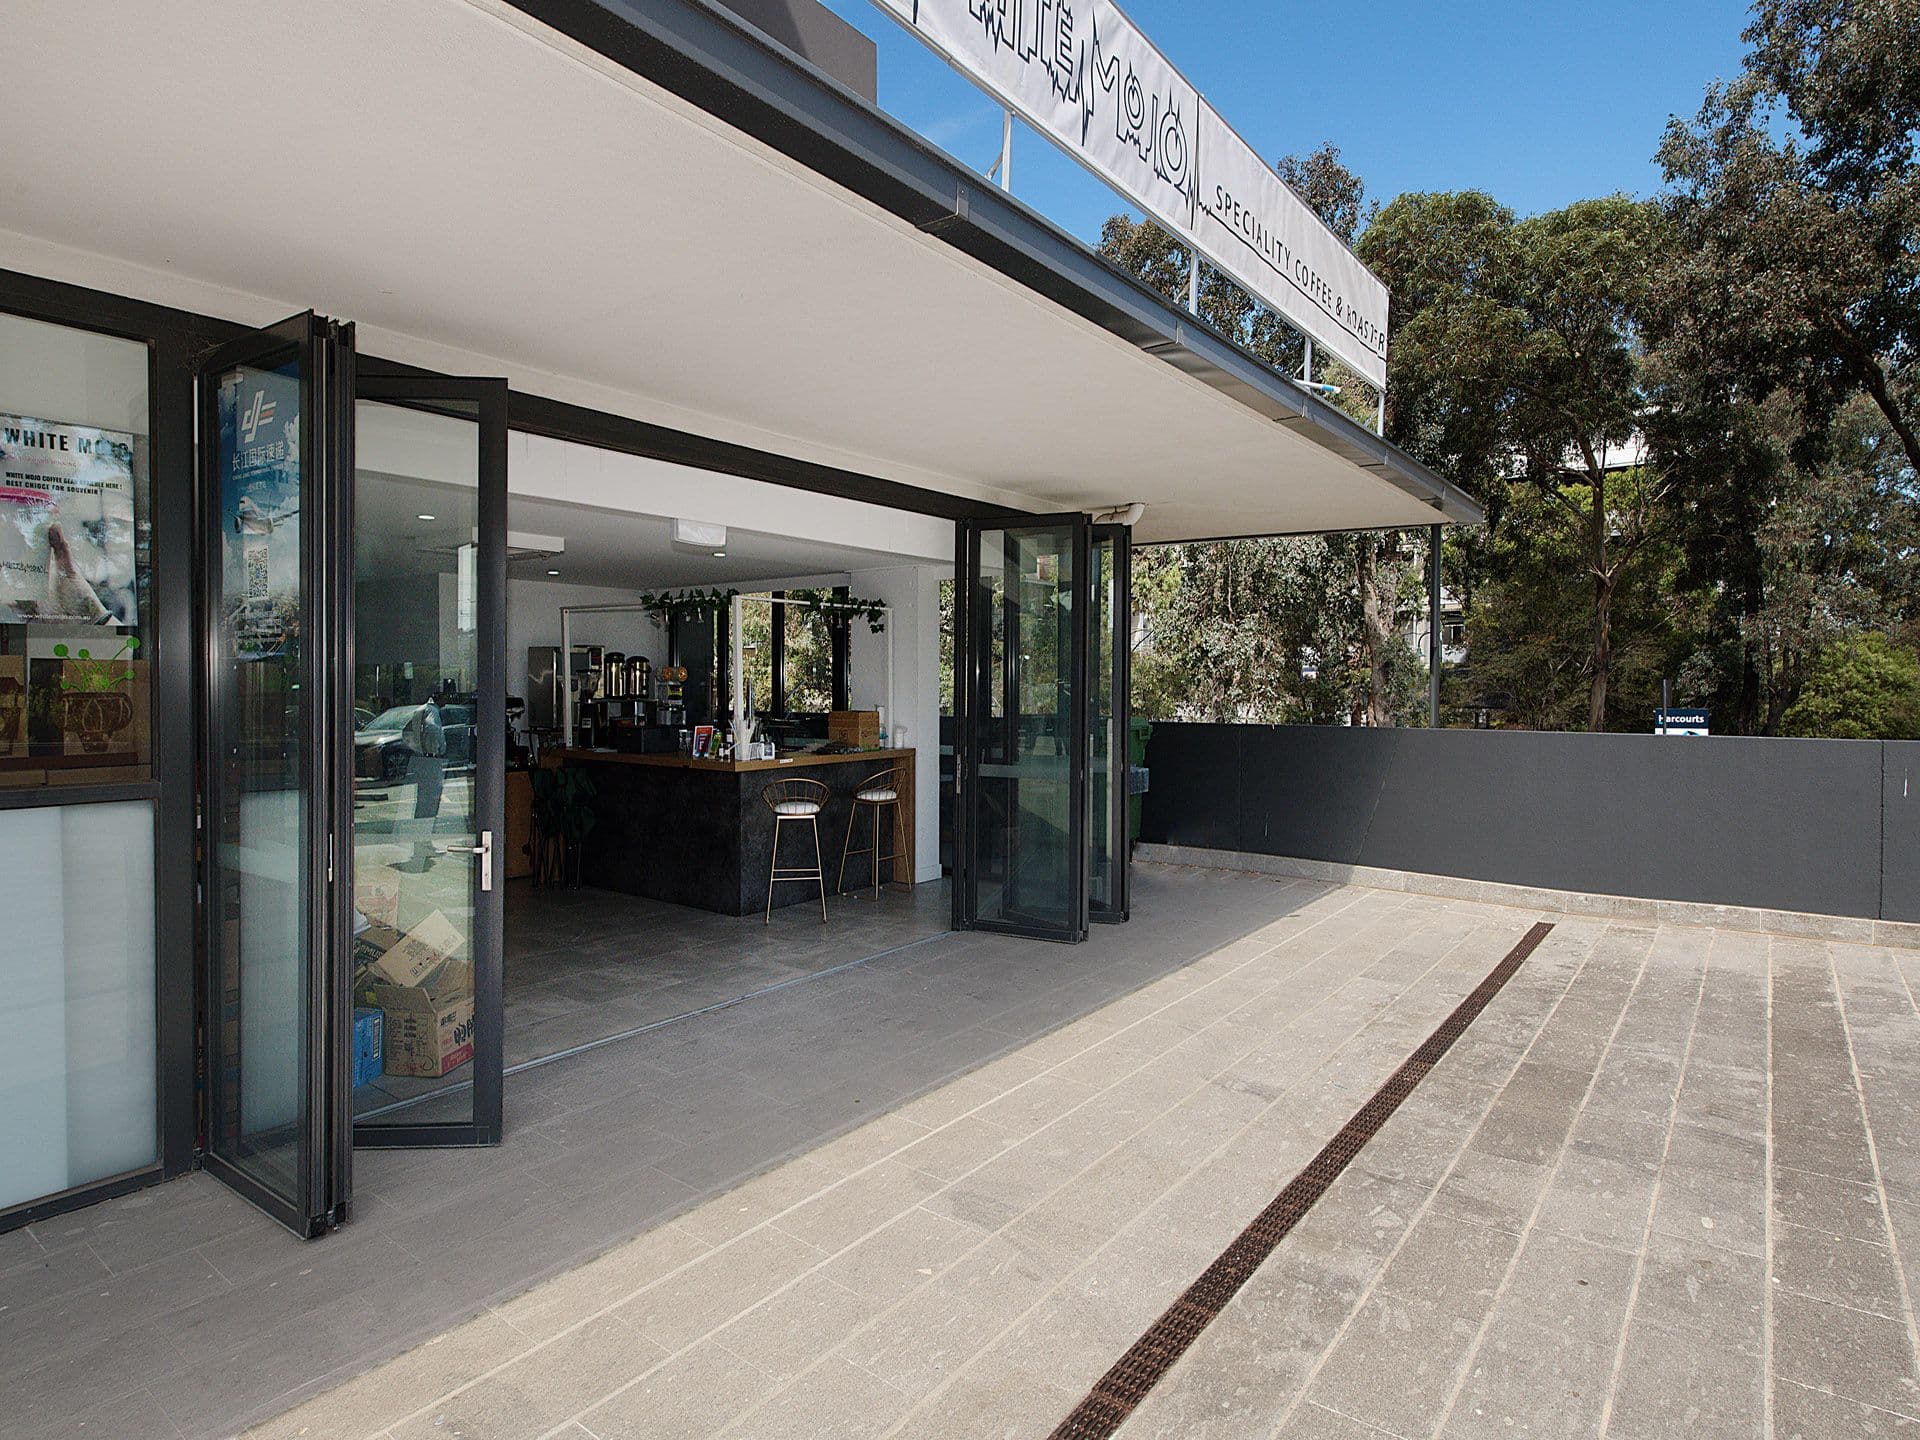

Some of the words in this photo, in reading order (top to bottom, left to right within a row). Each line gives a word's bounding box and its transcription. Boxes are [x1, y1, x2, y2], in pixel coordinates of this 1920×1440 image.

[1215, 185, 1291, 270] SPECIALITY
[1295, 259, 1332, 309] COFFEE
[1335, 296, 1342, 318] &
[4, 427, 69, 451] WHITE
[5, 471, 24, 480] WHITE
[25, 473, 41, 481] MOJO
[42, 475, 62, 484] COFFEE
[5, 479, 22, 488] BEST
[52, 484, 65, 492] FOR
